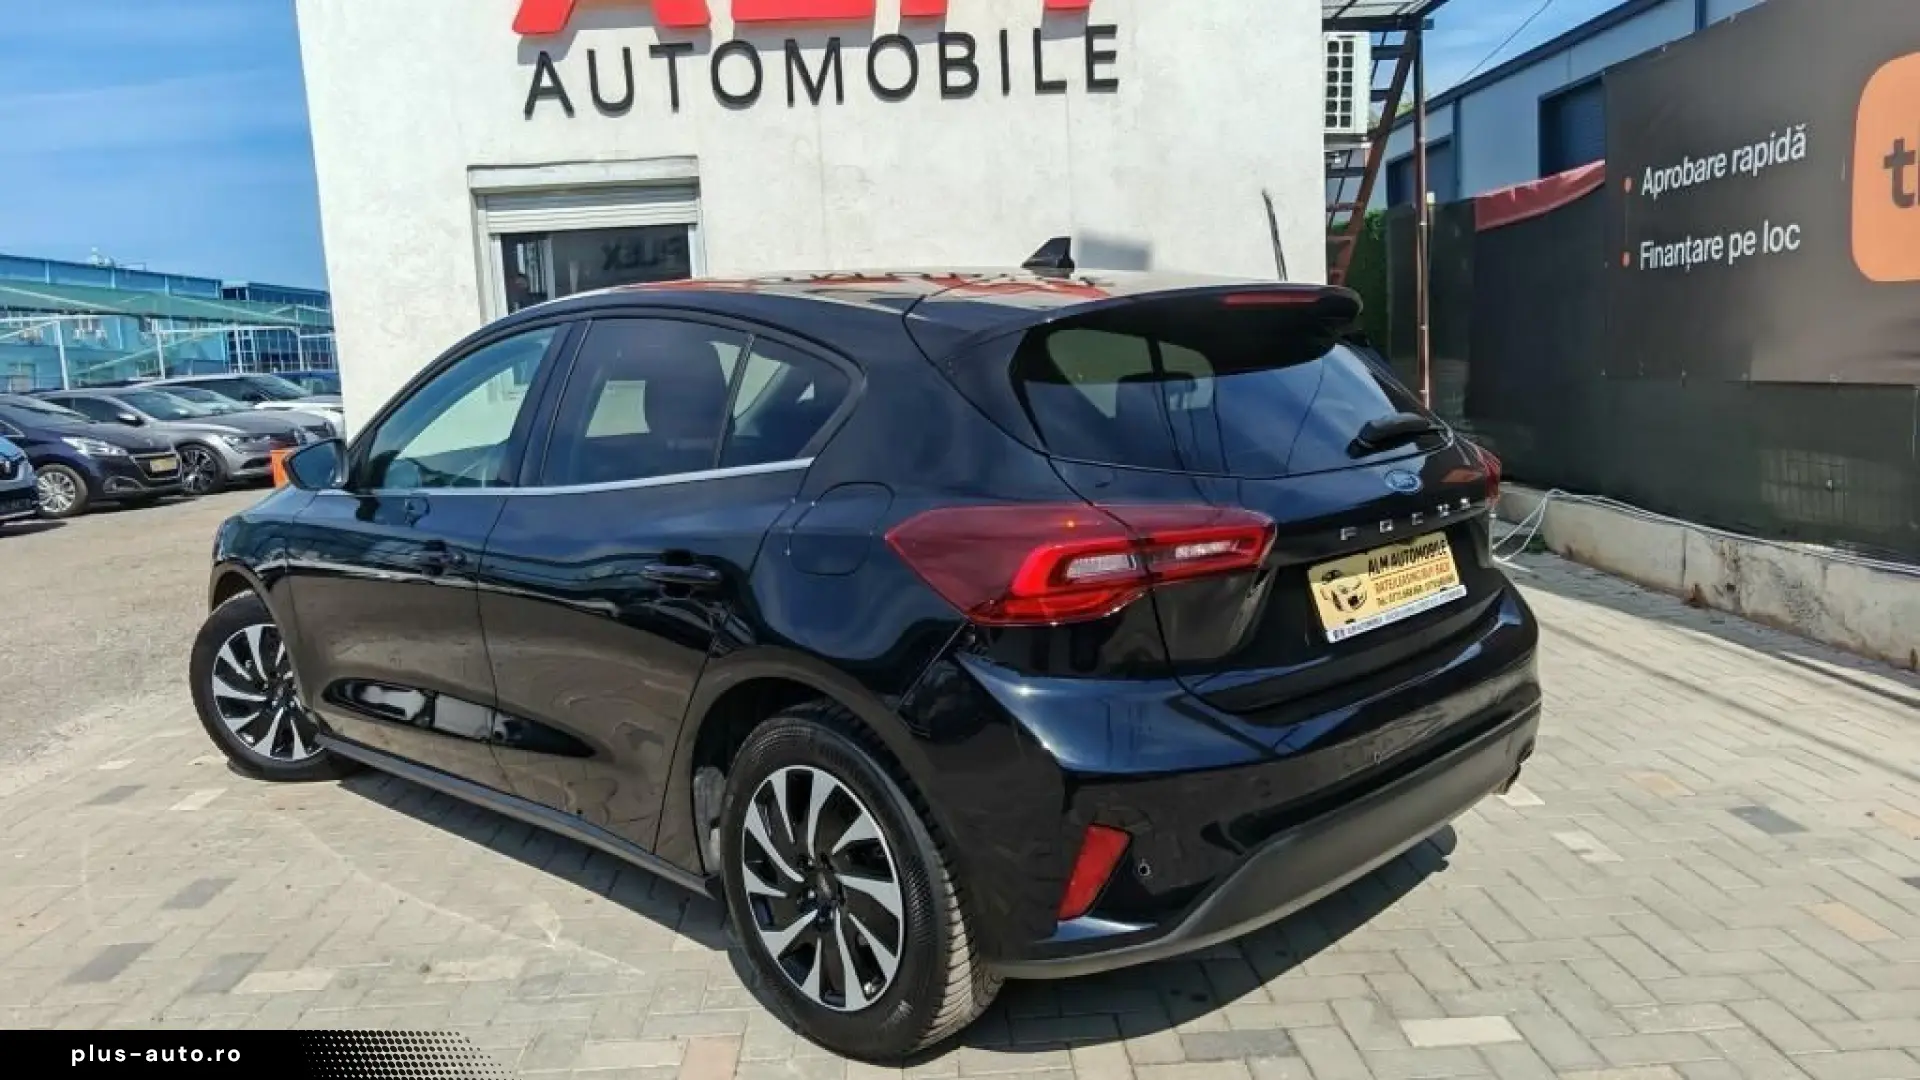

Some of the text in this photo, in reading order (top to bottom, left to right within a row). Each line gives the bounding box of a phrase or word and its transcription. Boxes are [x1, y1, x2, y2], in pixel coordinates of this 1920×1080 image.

[524, 25, 1119, 119] AUTOMOBILE
[1641, 123, 1807, 200] Aprobare rapidă
[1883, 125, 1920, 208] t
[1639, 219, 1801, 273] Finanțare pe loc
